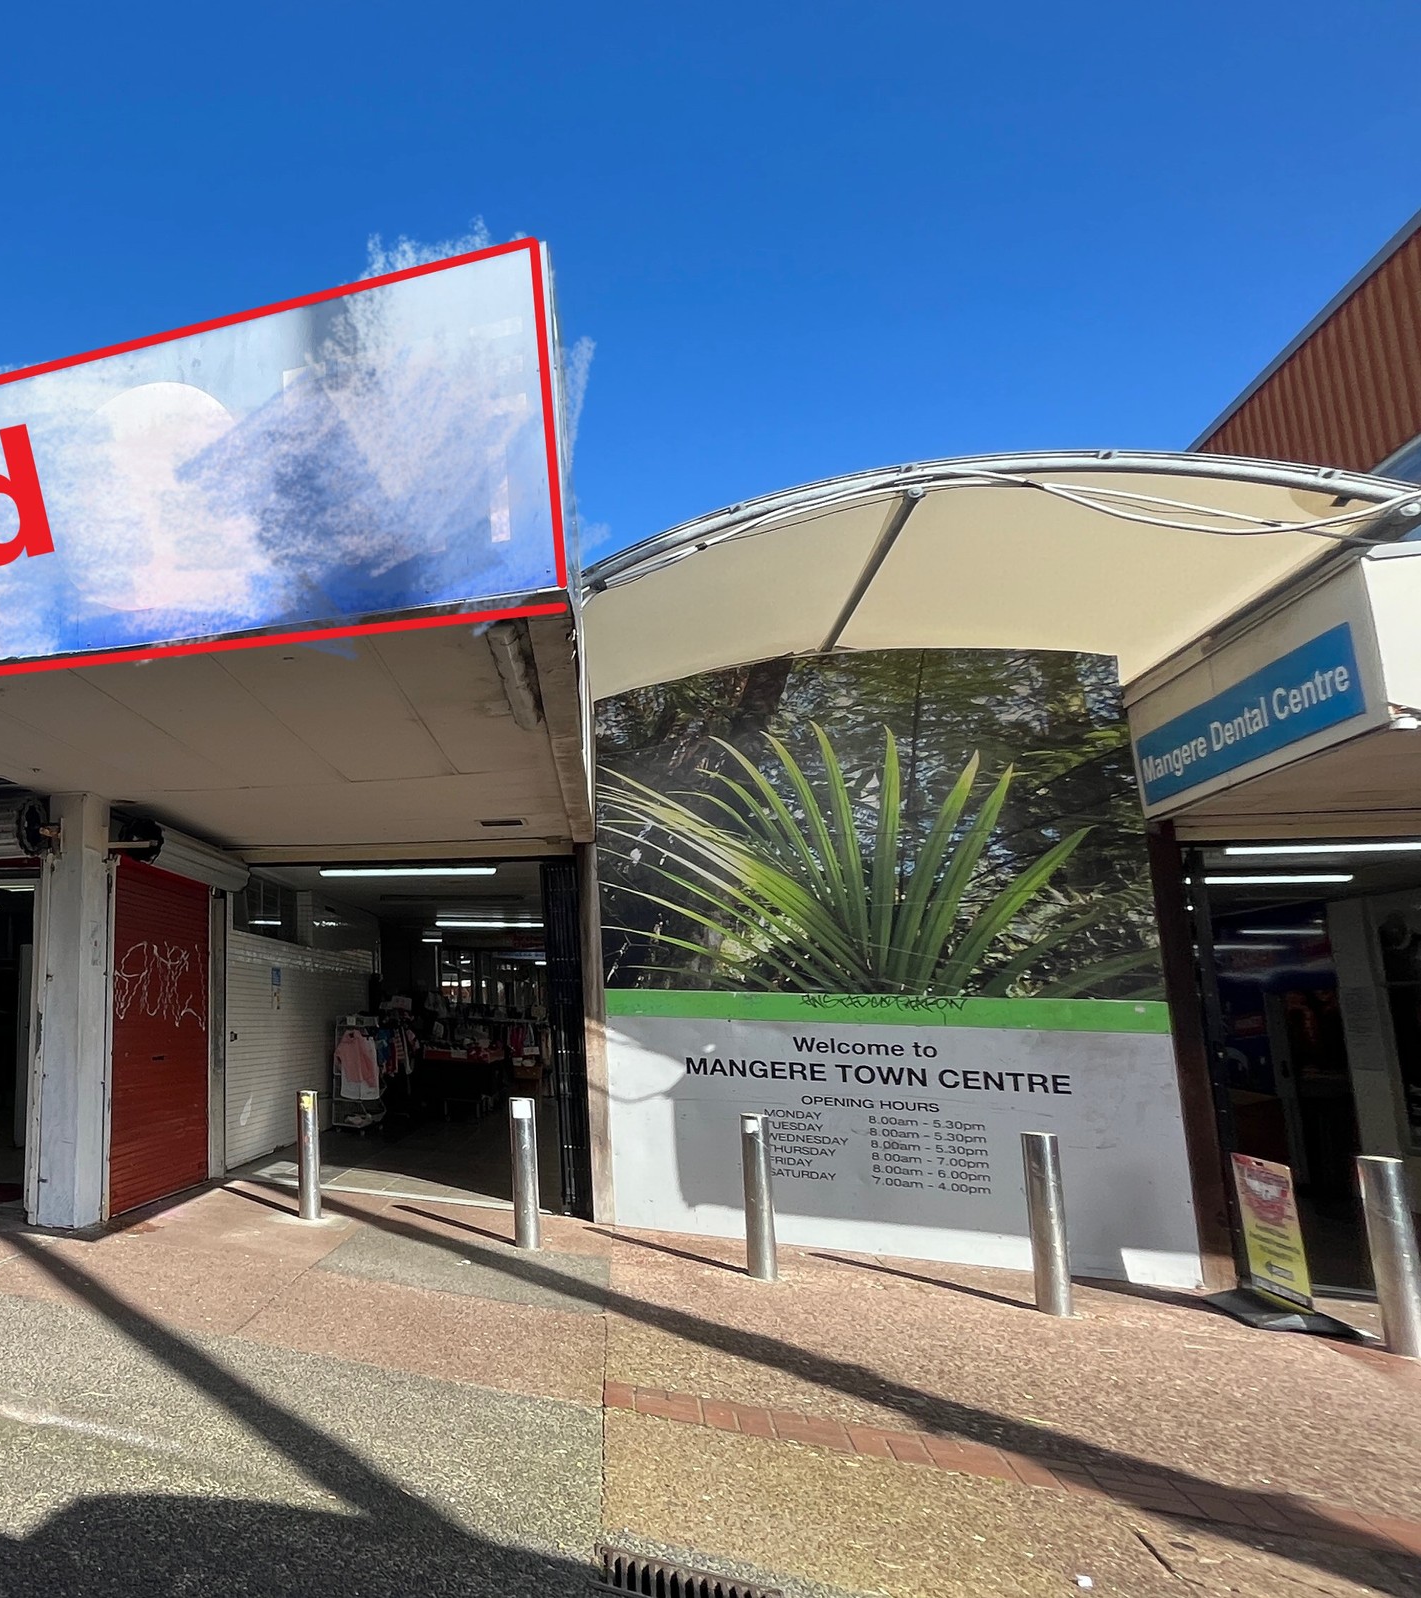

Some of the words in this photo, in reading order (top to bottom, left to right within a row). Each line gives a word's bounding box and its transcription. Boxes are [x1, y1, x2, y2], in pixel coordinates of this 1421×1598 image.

[1142, 736, 1207, 784] Mangere
[1209, 696, 1270, 752] Dental
[1272, 665, 1350, 720] Centre
[792, 1036, 905, 1058] Welcome
[912, 1040, 938, 1059] to
[685, 1057, 827, 1082] MANGERE
[834, 1063, 928, 1088] TOWN
[938, 1068, 1073, 1096] CENTRE
[801, 1095, 875, 1110] OPENING
[880, 1099, 940, 1113] HOURS
[764, 1108, 822, 1120] MONDAY
[869, 1115, 918, 1127] 8.00am
[932, 1119, 986, 1131] 5.30pm
[869, 1127, 920, 1139] 8.00am
[934, 1132, 987, 1144] 5.30pm
[870, 1140, 921, 1152] 8.00am
[935, 1144, 988, 1157] 5.30pm
[871, 1152, 922, 1164] 8.00am
[936, 1156, 990, 1169] 7.00pm
[872, 1164, 923, 1176] 8.00am
[937, 1169, 991, 1182] 6.00pm
[871, 1175, 924, 1189] 7.00am
[938, 1182, 992, 1195] 4.00pm
